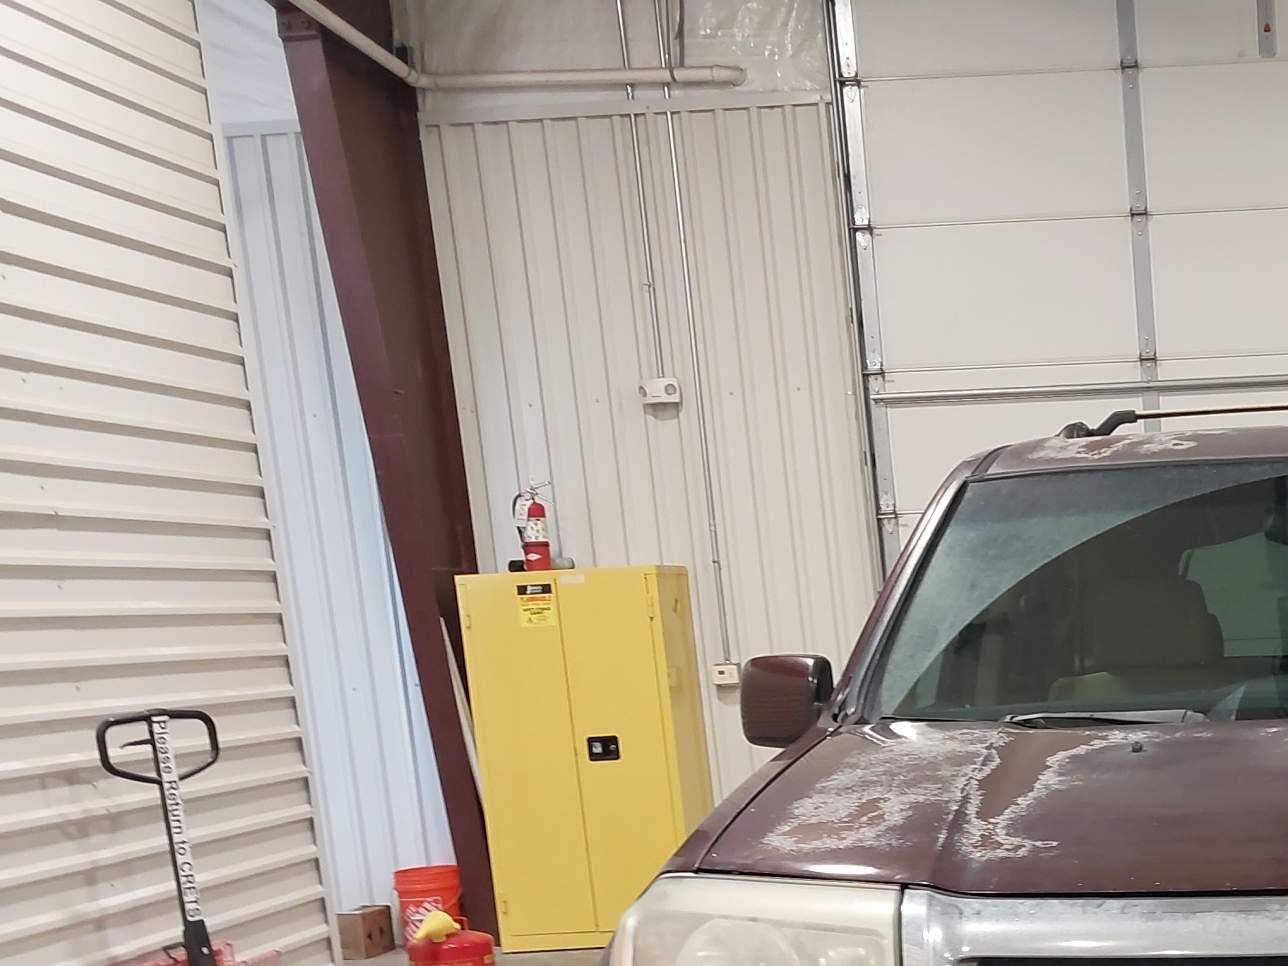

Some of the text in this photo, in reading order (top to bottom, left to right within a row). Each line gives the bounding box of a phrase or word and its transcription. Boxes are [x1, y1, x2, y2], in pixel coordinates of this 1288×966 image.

[151, 720, 173, 774] Please
[163, 780, 184, 835] Return
[174, 840, 190, 856] to
